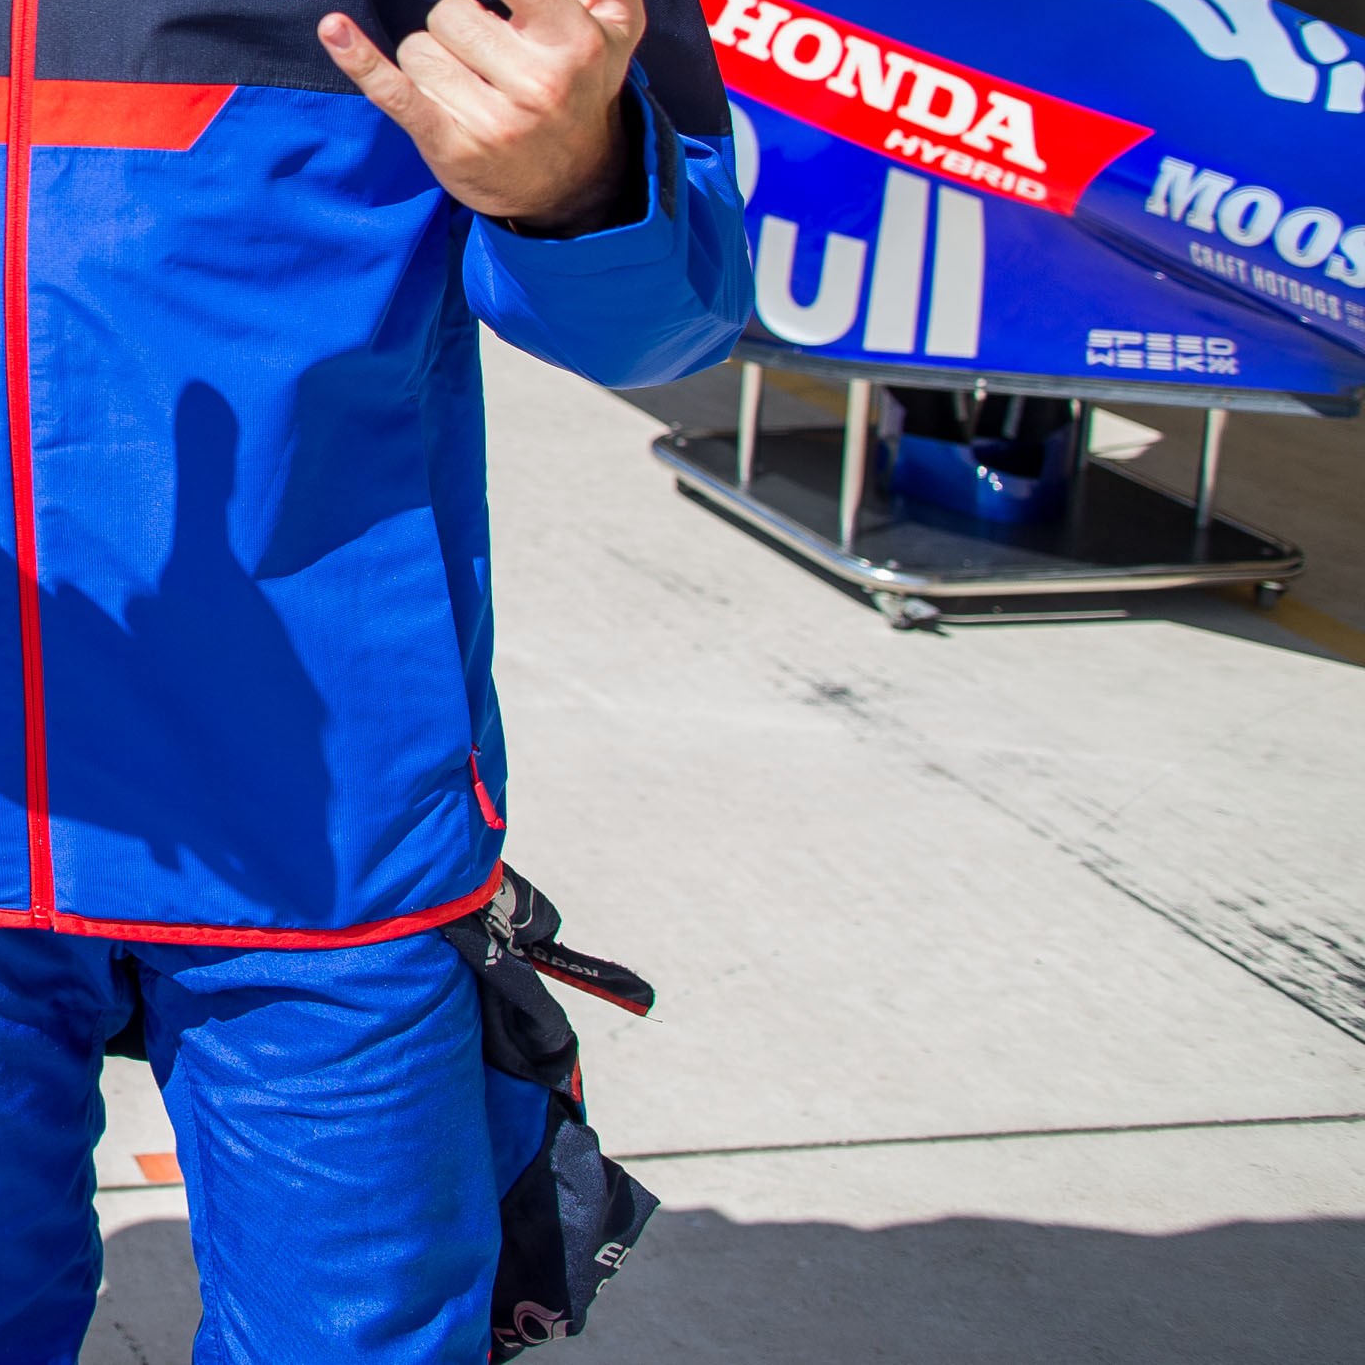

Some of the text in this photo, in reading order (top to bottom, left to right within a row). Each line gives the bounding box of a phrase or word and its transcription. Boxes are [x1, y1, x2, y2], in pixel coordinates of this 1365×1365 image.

[884, 129, 1048, 202] HYBRID
[1188, 240, 1248, 284] CRAFT
[1251, 264, 1342, 322] HOTDOGS
